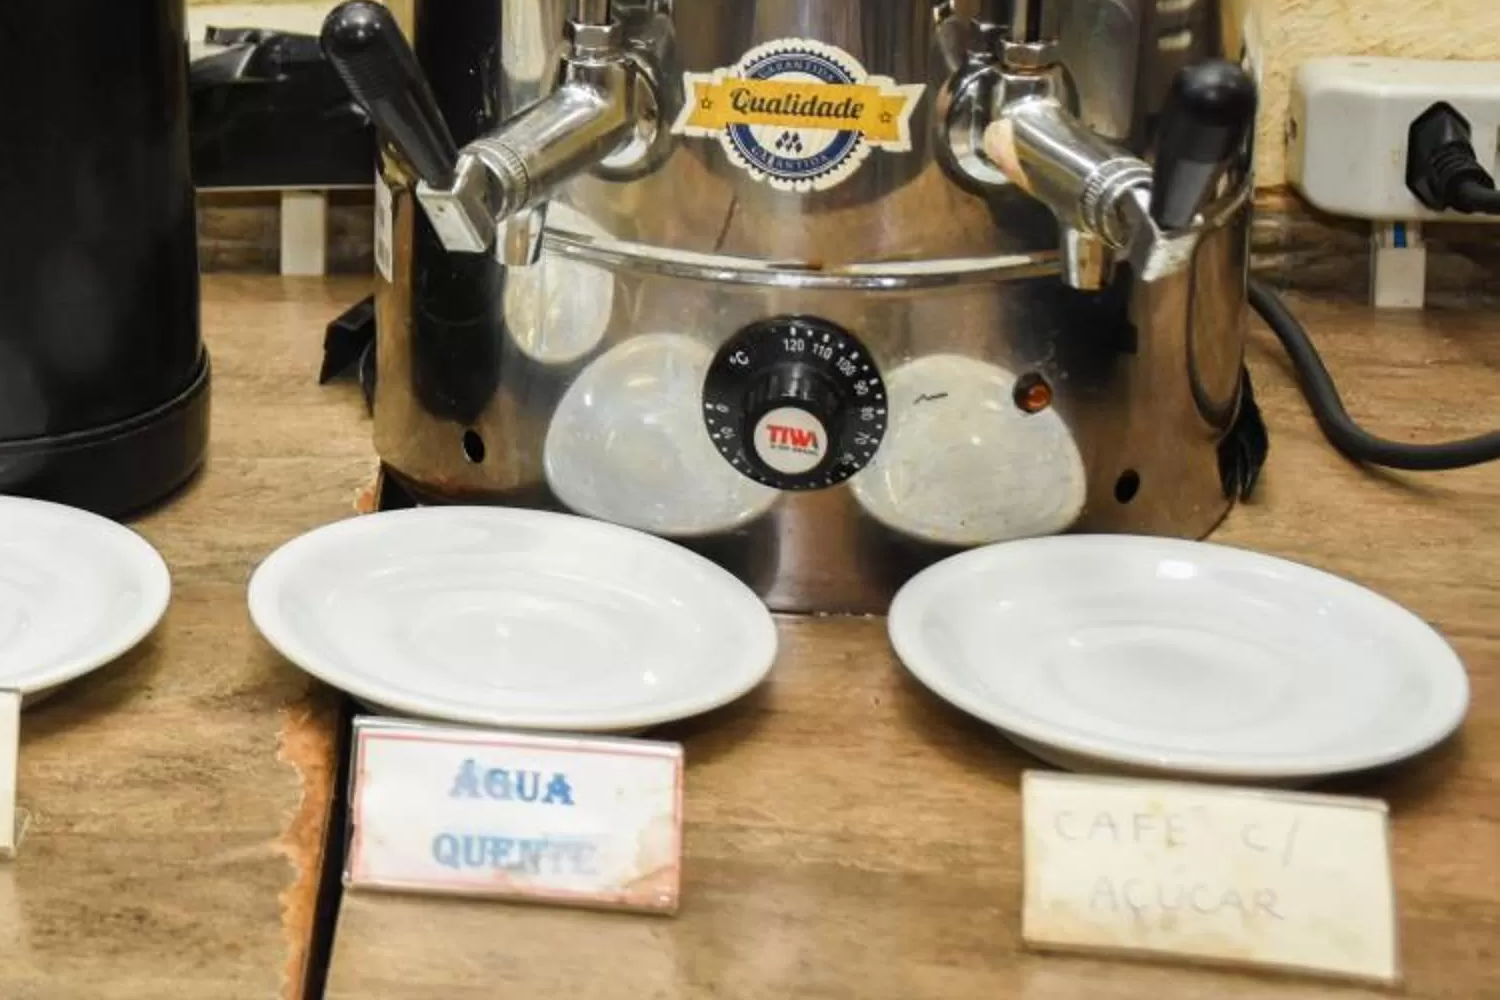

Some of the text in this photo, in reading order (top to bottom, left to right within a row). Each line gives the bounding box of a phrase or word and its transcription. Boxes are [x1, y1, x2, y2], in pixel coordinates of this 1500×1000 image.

[730, 87, 864, 120] Qualidade
[783, 338, 805, 353] 120
[812, 343, 833, 361] 110
[836, 356, 857, 376] 100
[449, 758, 576, 806] ÁGUA
[431, 832, 601, 876] QUENTE
